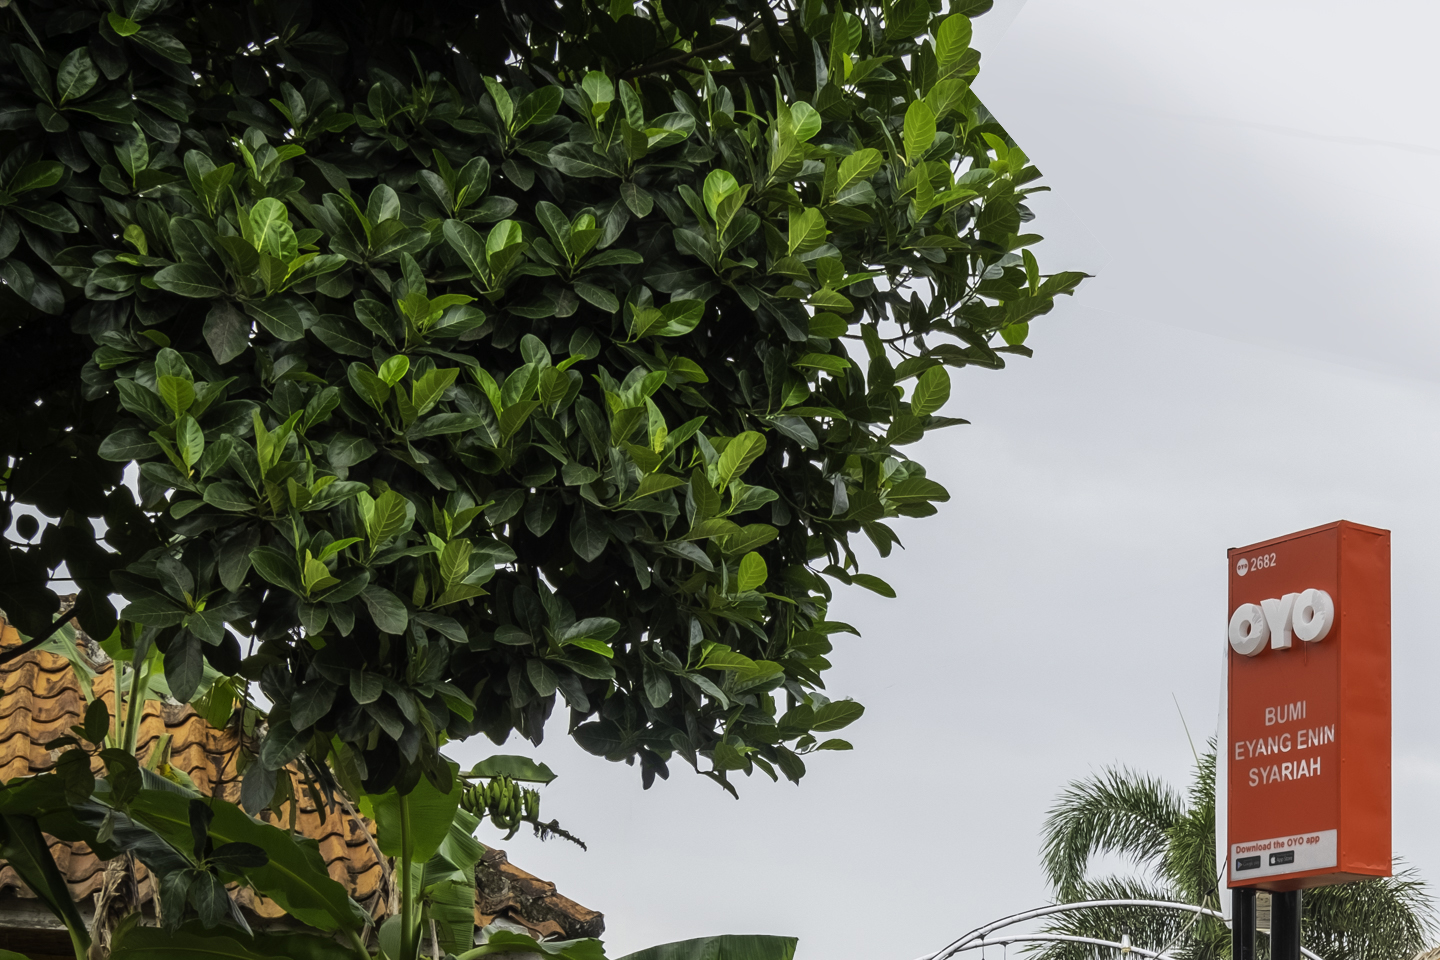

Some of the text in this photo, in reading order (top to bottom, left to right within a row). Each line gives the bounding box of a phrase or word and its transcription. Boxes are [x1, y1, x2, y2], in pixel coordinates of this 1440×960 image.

[1250, 552, 1277, 572] 2682
[1229, 588, 1335, 657] OYO
[1265, 700, 1307, 726] BUMI
[1235, 724, 1335, 760] EYANG ENIN
[1248, 756, 1321, 787] SYARIAH
[1236, 836, 1320, 854] Download the OYO app
